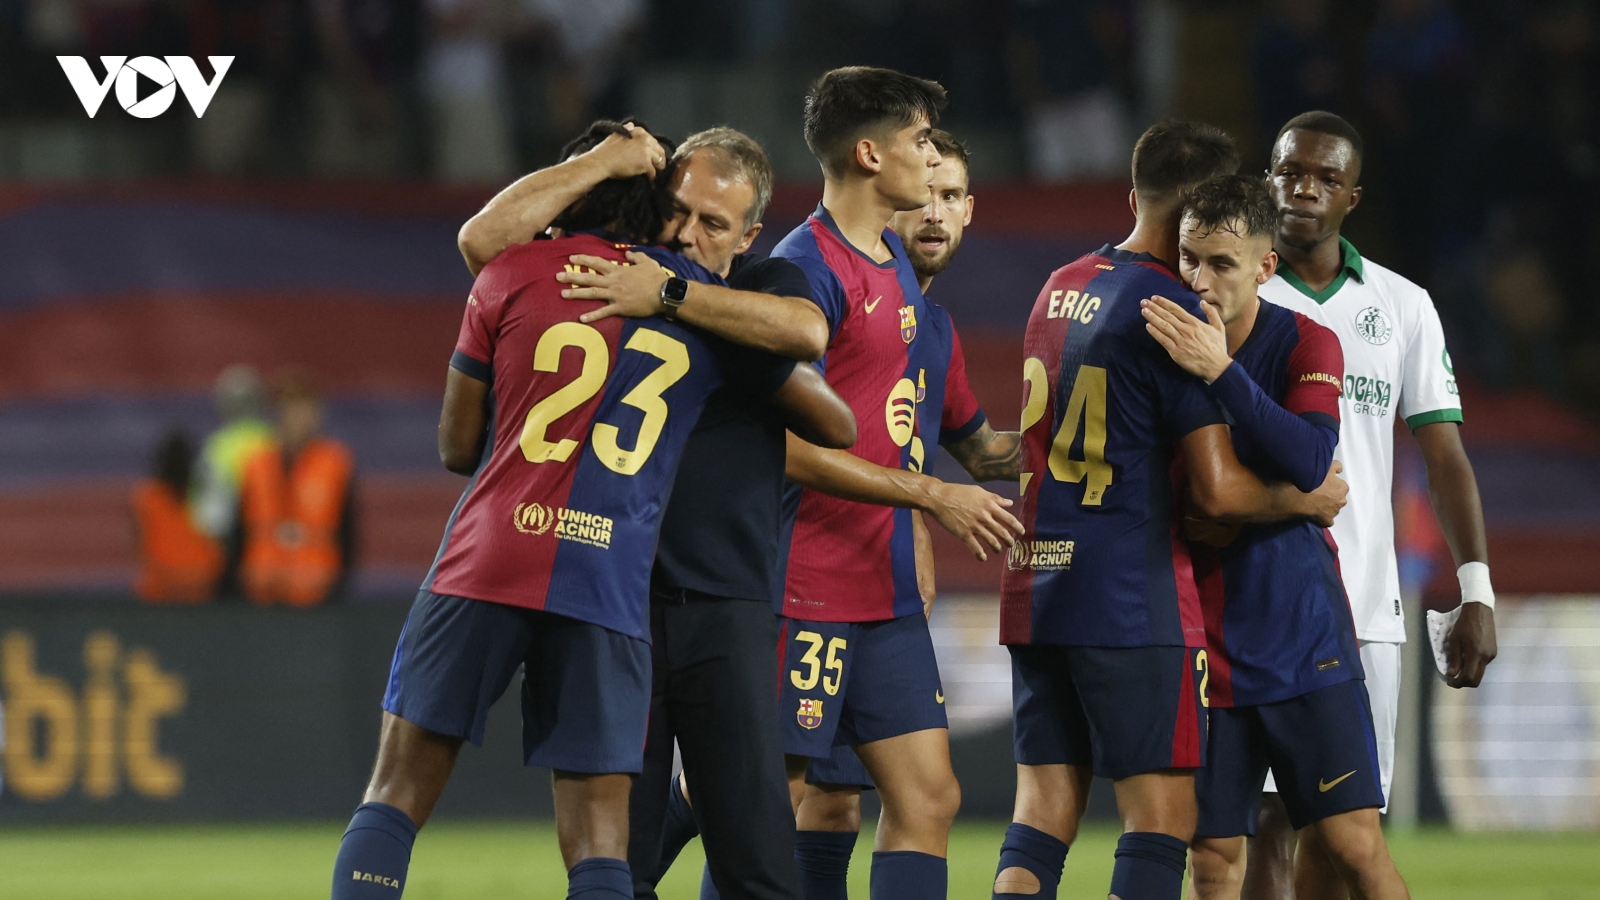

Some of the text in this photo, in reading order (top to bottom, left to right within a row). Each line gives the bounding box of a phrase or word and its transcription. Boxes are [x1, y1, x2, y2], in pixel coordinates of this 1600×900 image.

[1046, 290, 1101, 324] ERIC
[519, 321, 690, 475] 23
[1340, 374, 1391, 408] OCASA
[554, 521, 612, 544] ACNUR
[557, 507, 613, 532] UNHCR
[1030, 553, 1072, 565] ACNUR
[1031, 541, 1075, 553] UNHCR
[790, 631, 847, 696] 35
[0, 630, 187, 797] bit
